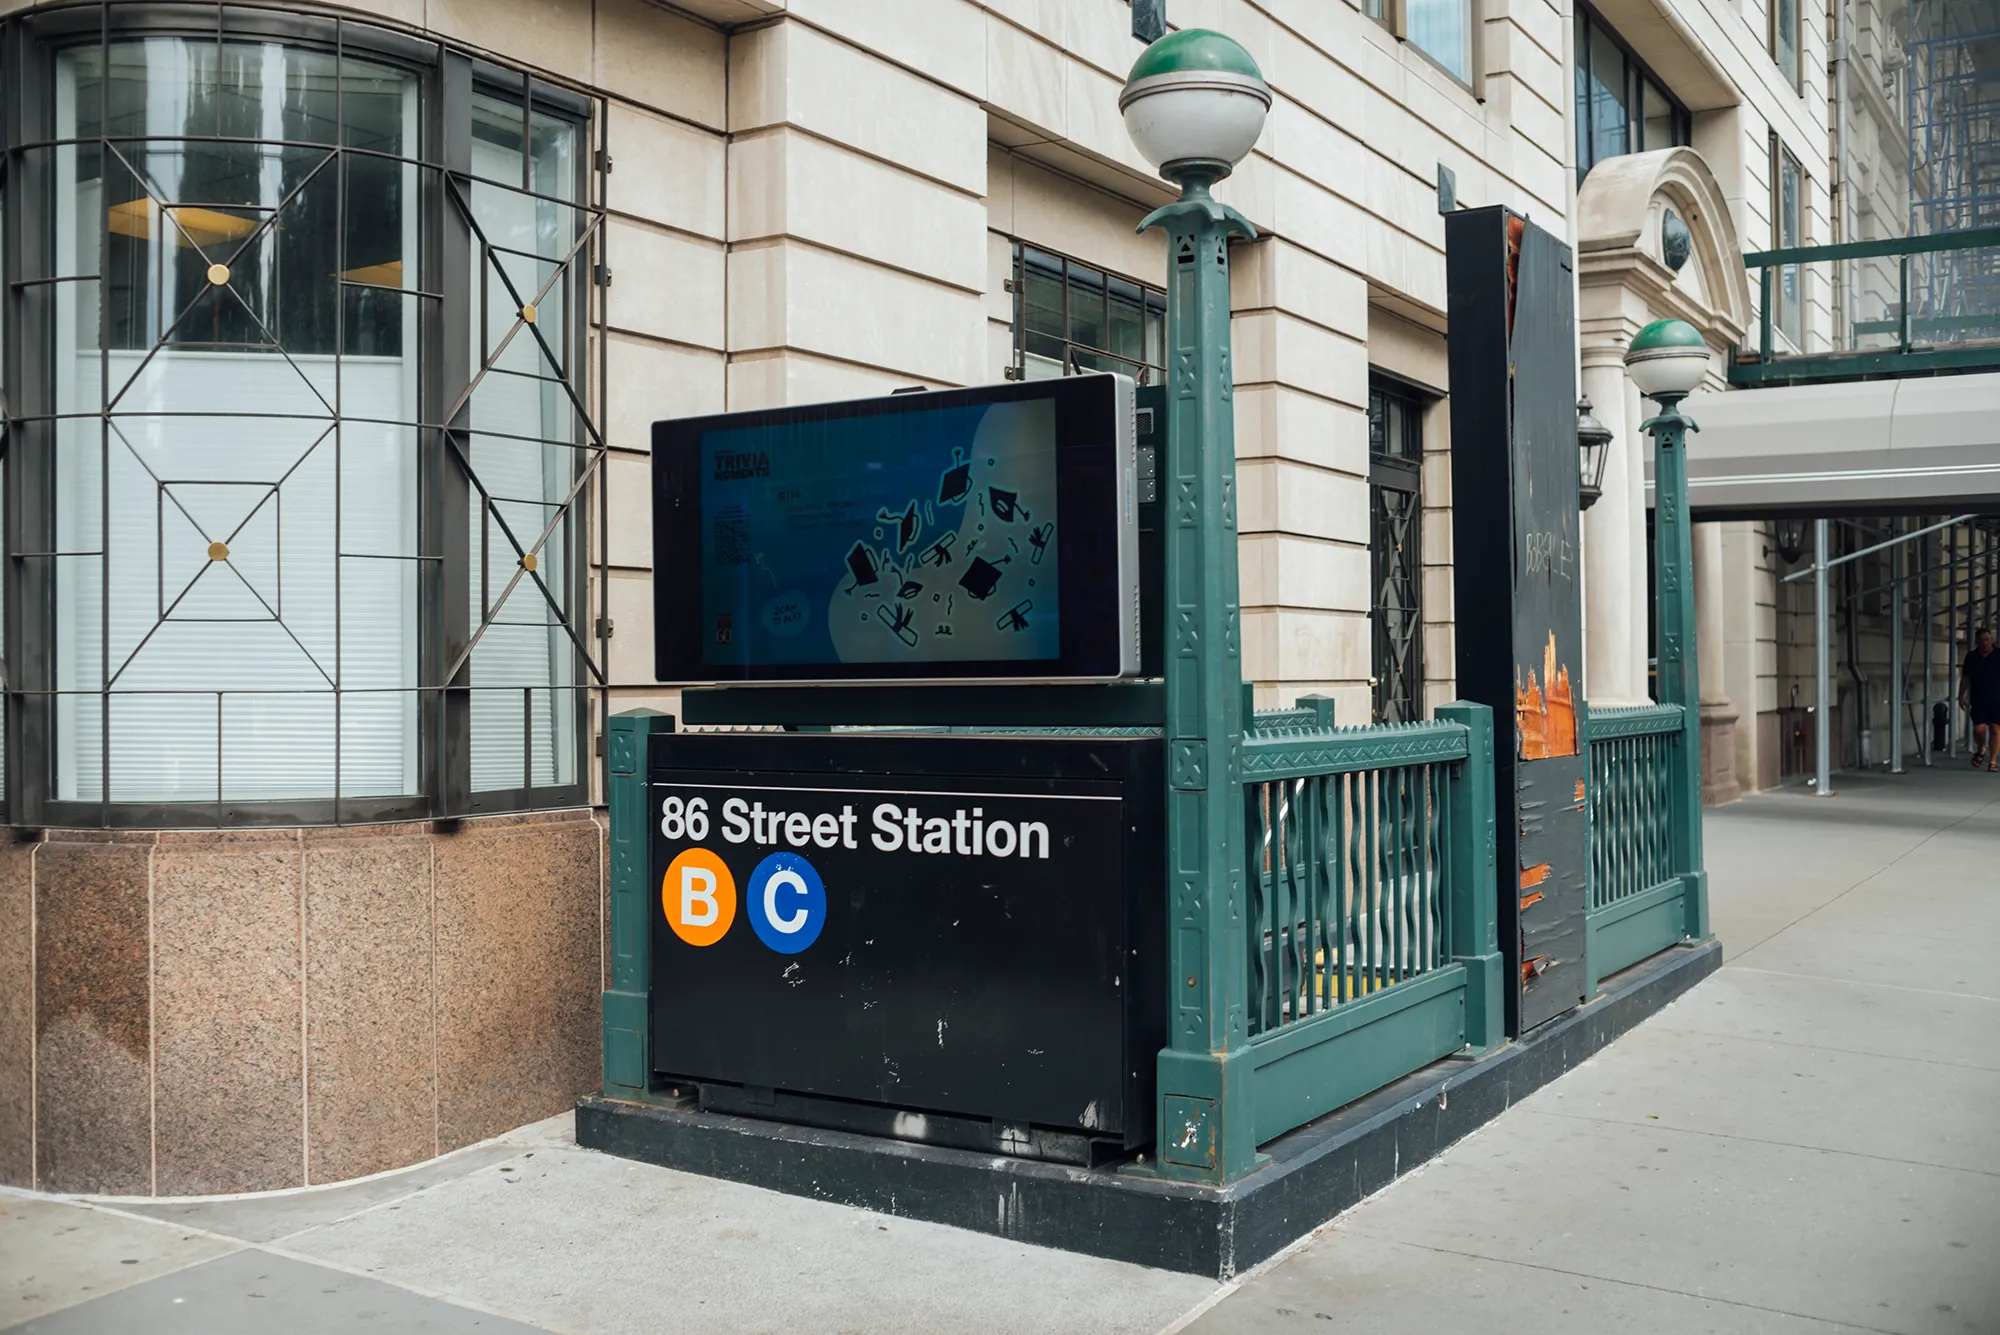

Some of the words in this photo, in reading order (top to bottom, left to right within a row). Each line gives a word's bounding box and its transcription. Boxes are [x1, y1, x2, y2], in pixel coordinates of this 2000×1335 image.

[714, 452, 770, 469] TRIVIA
[661, 796, 710, 841] 86
[721, 797, 858, 849] Street
[871, 803, 1050, 858] Station
[680, 866, 719, 927] B
[763, 870, 809, 934] C
